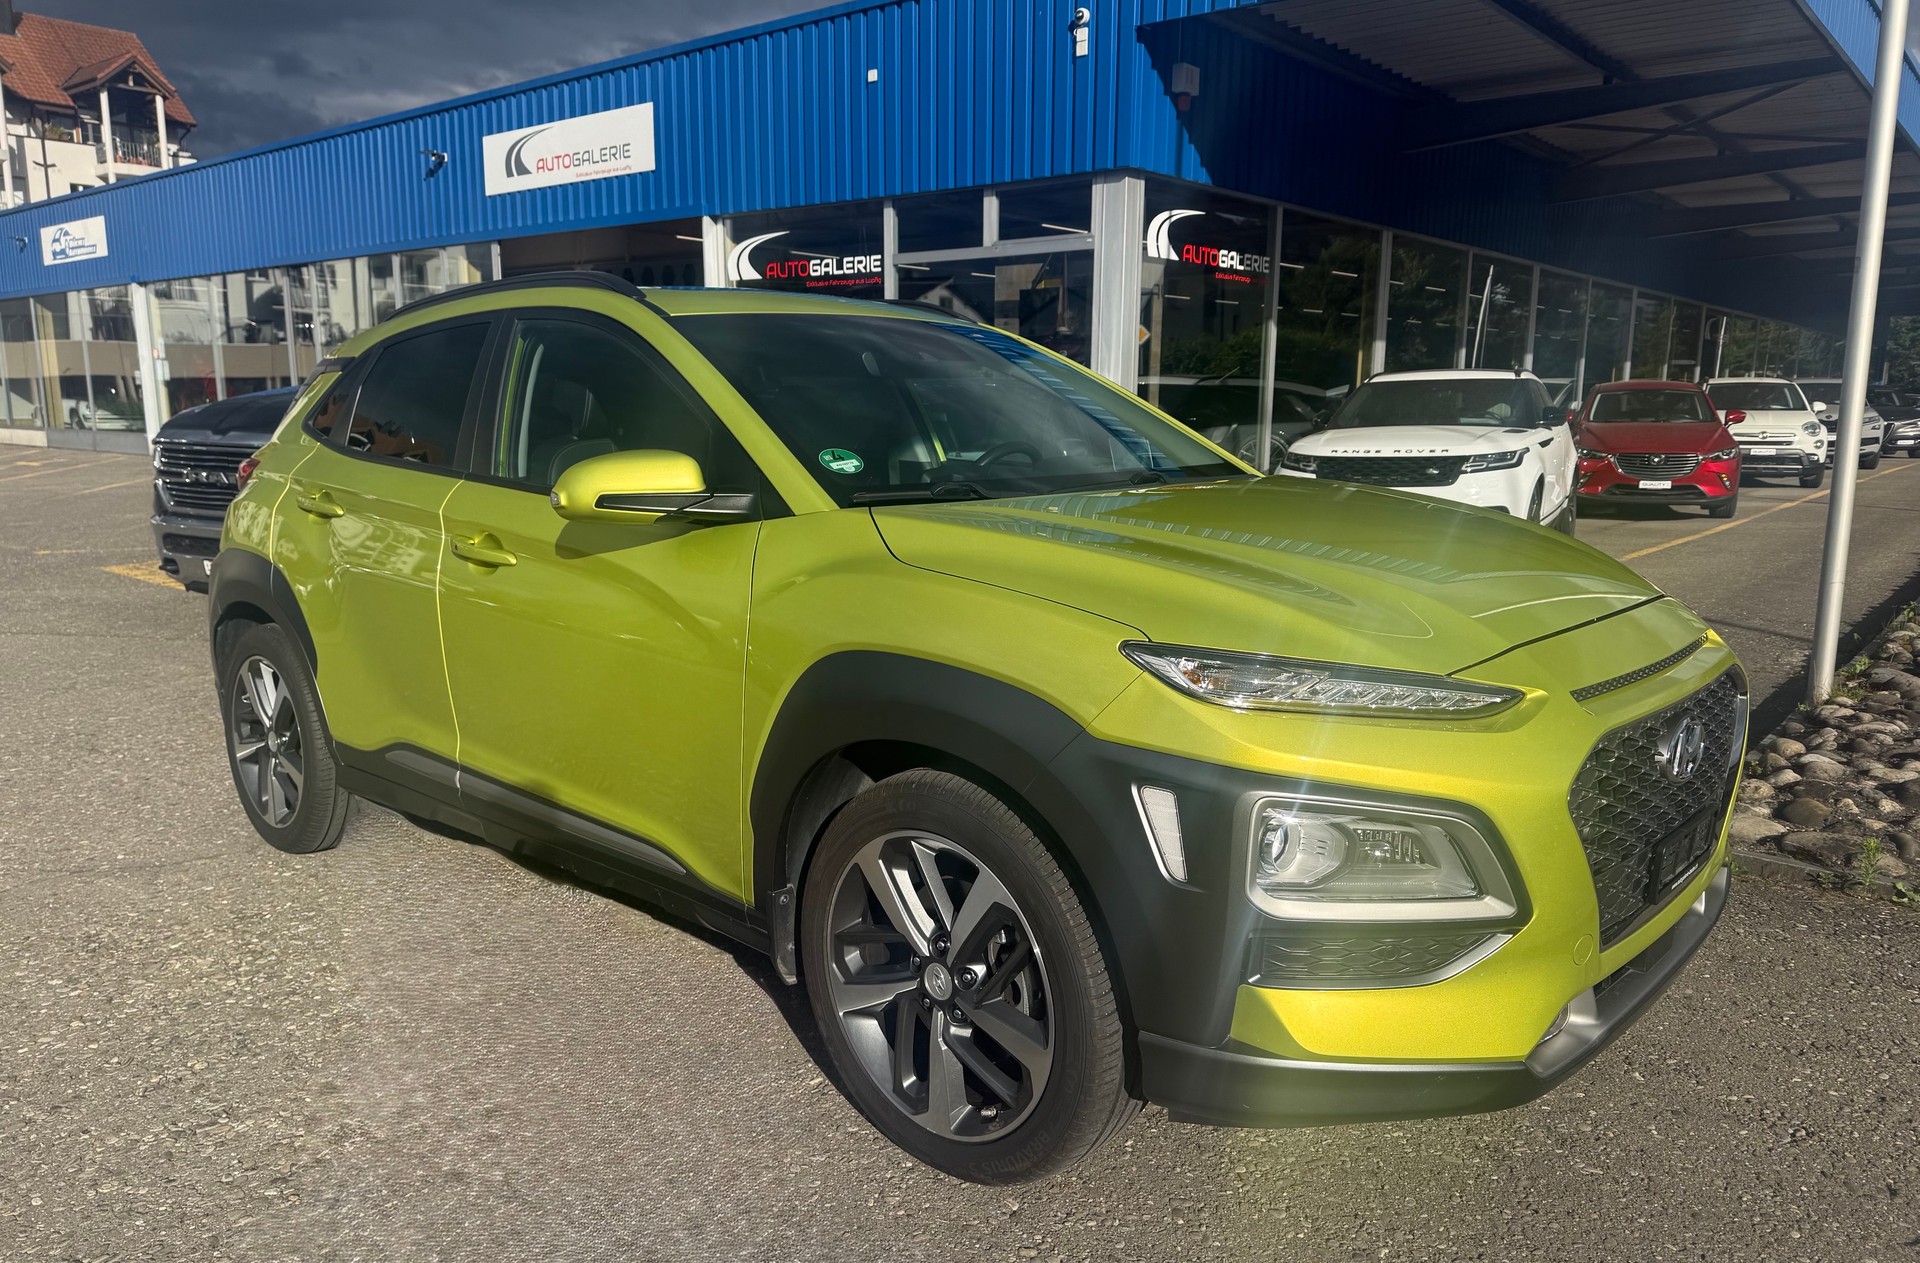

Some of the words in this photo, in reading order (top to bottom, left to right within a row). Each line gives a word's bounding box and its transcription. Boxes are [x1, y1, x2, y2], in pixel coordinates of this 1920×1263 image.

[536, 143, 631, 174] AUTOGALERIE
[766, 254, 882, 279] AUTOGALERIE
[1183, 244, 1271, 273] AUTOGALERIE
[982, 1130, 1052, 1174] BRAVURIS
